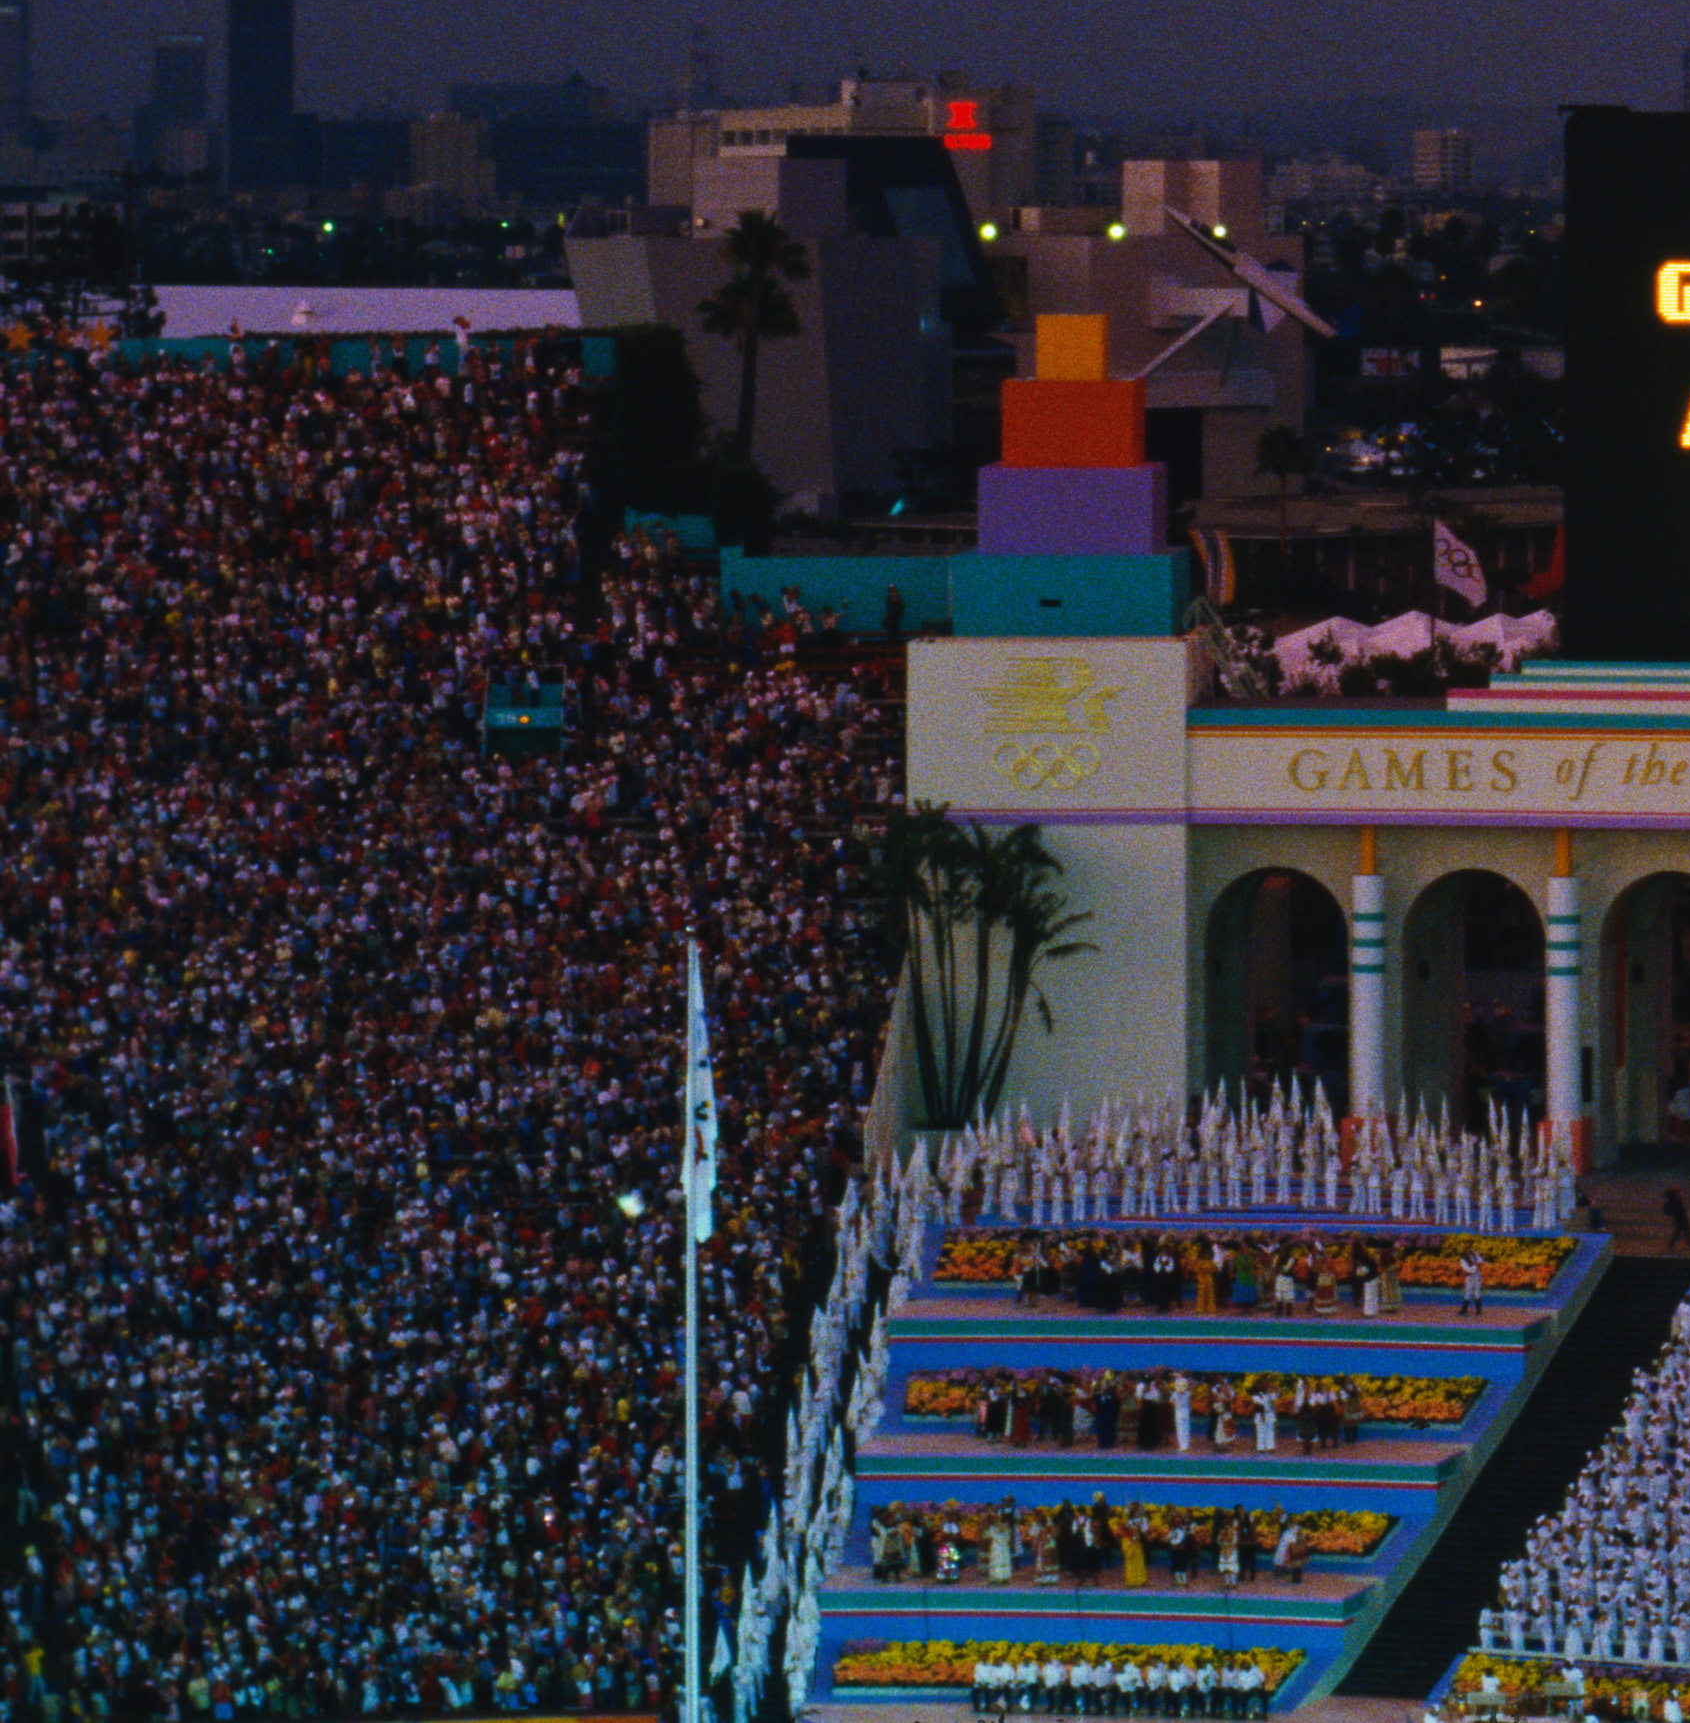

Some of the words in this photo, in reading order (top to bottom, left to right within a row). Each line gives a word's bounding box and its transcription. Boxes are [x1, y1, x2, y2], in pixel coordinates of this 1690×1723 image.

[1286, 747, 1519, 795] GAMES
[1555, 742, 1606, 801] of
[1620, 742, 1689, 787] the
